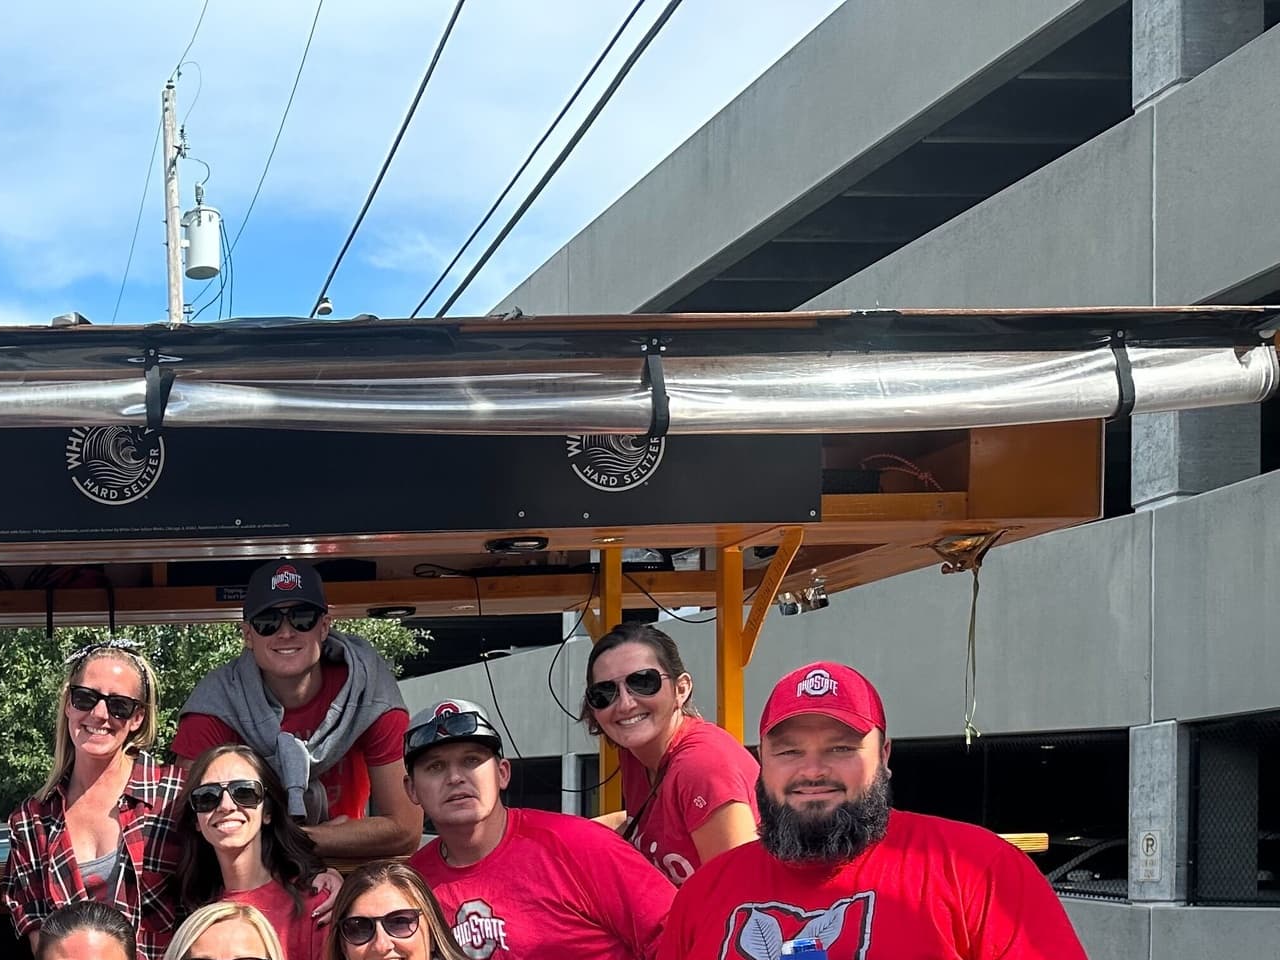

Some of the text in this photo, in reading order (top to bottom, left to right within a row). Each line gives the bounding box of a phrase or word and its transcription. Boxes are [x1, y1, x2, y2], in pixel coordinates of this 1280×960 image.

[66, 426, 91, 470] WHI
[583, 465, 618, 486] HARD
[623, 437, 660, 484] SELTZER
[83, 448, 160, 500] HARD SELTZER
